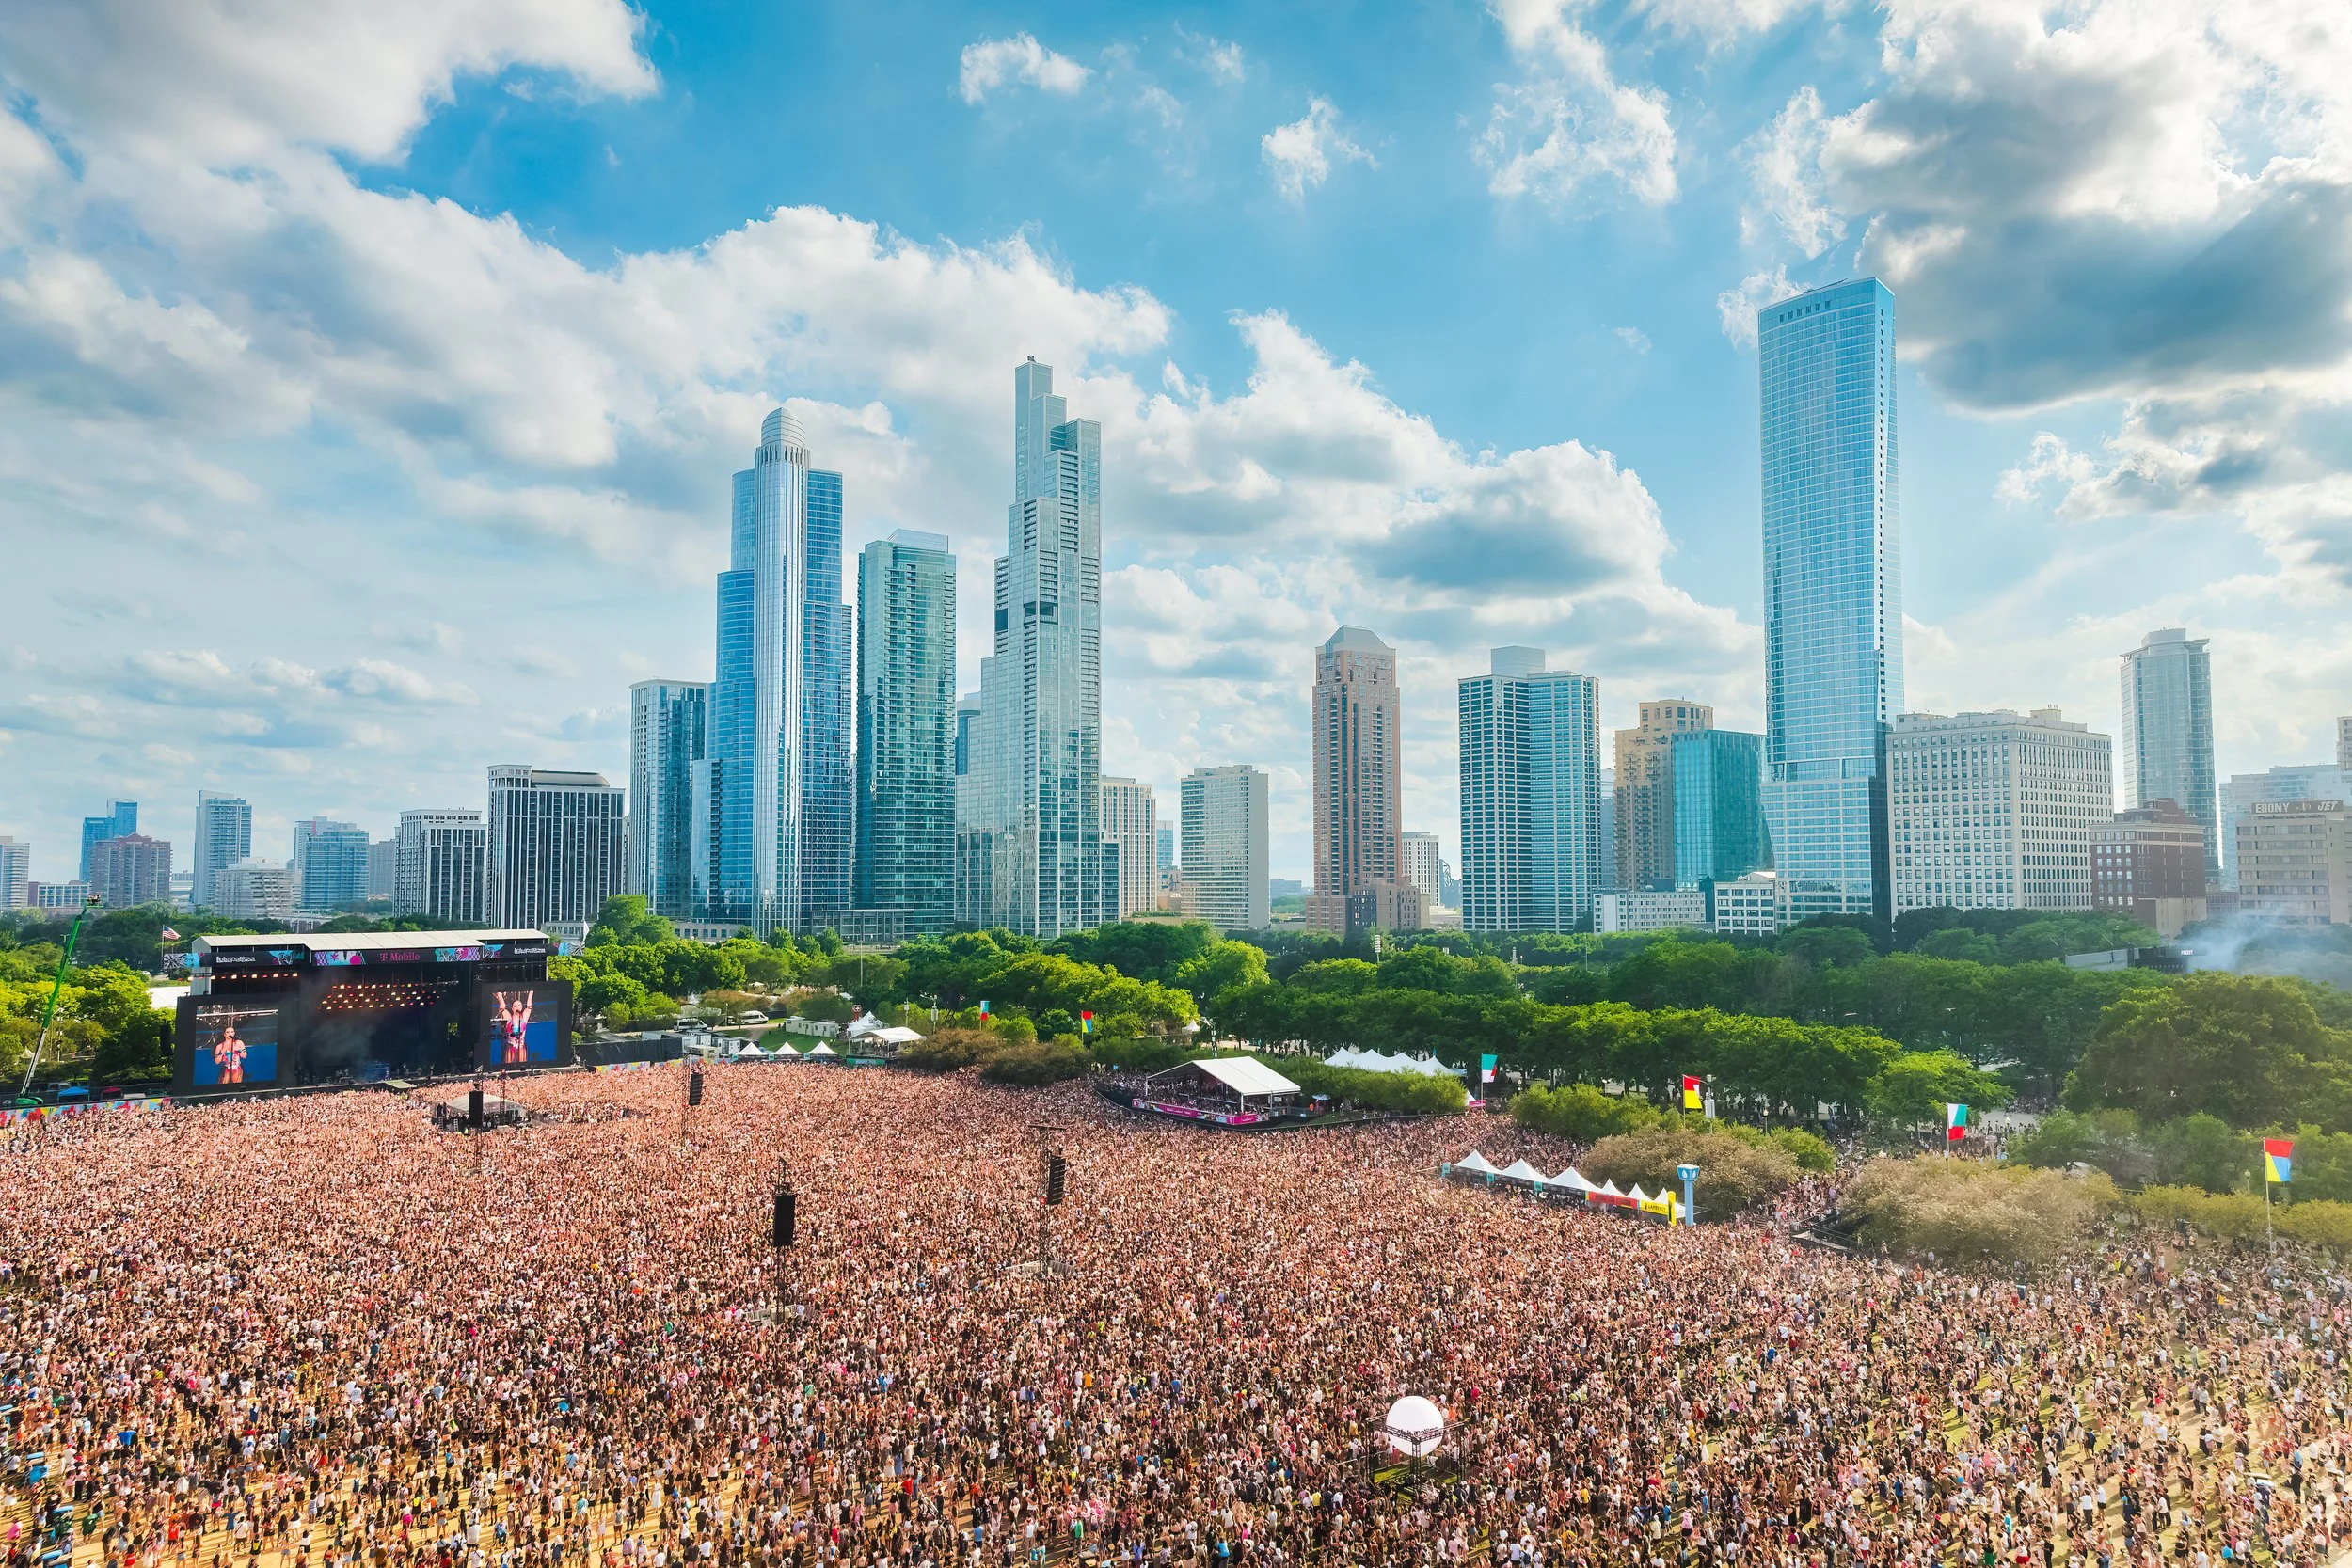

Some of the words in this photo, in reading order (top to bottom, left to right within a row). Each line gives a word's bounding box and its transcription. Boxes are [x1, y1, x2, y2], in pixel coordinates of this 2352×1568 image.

[2255, 802, 2290, 814] EBONY
[2317, 800, 2339, 812] JET
[390, 952, 421, 961] Mobile
